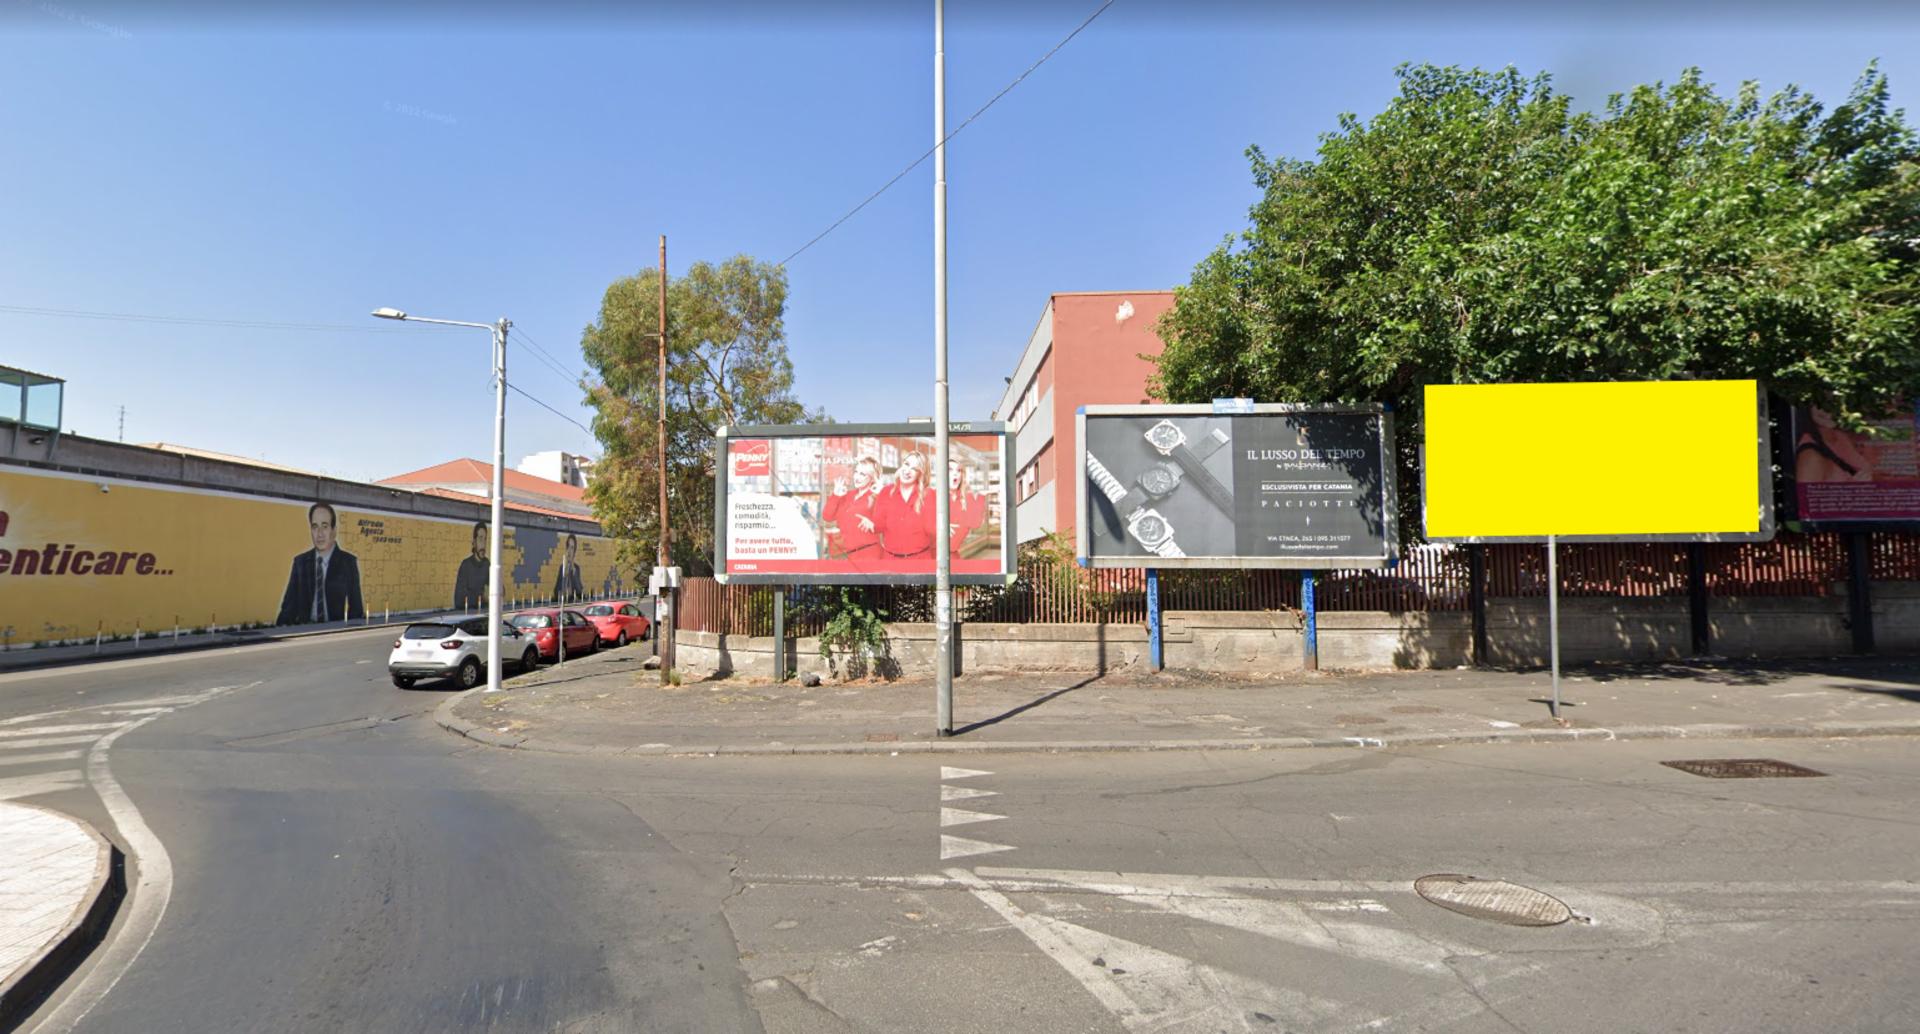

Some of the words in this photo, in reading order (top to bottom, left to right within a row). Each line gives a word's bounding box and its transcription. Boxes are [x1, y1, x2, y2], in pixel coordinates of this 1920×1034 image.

[735, 452, 768, 463] PENNY
[1247, 450, 1258, 460] IL
[1261, 450, 1297, 460] LUSSO
[1300, 449, 1322, 460] DEL
[1325, 449, 1365, 459] TEMPO
